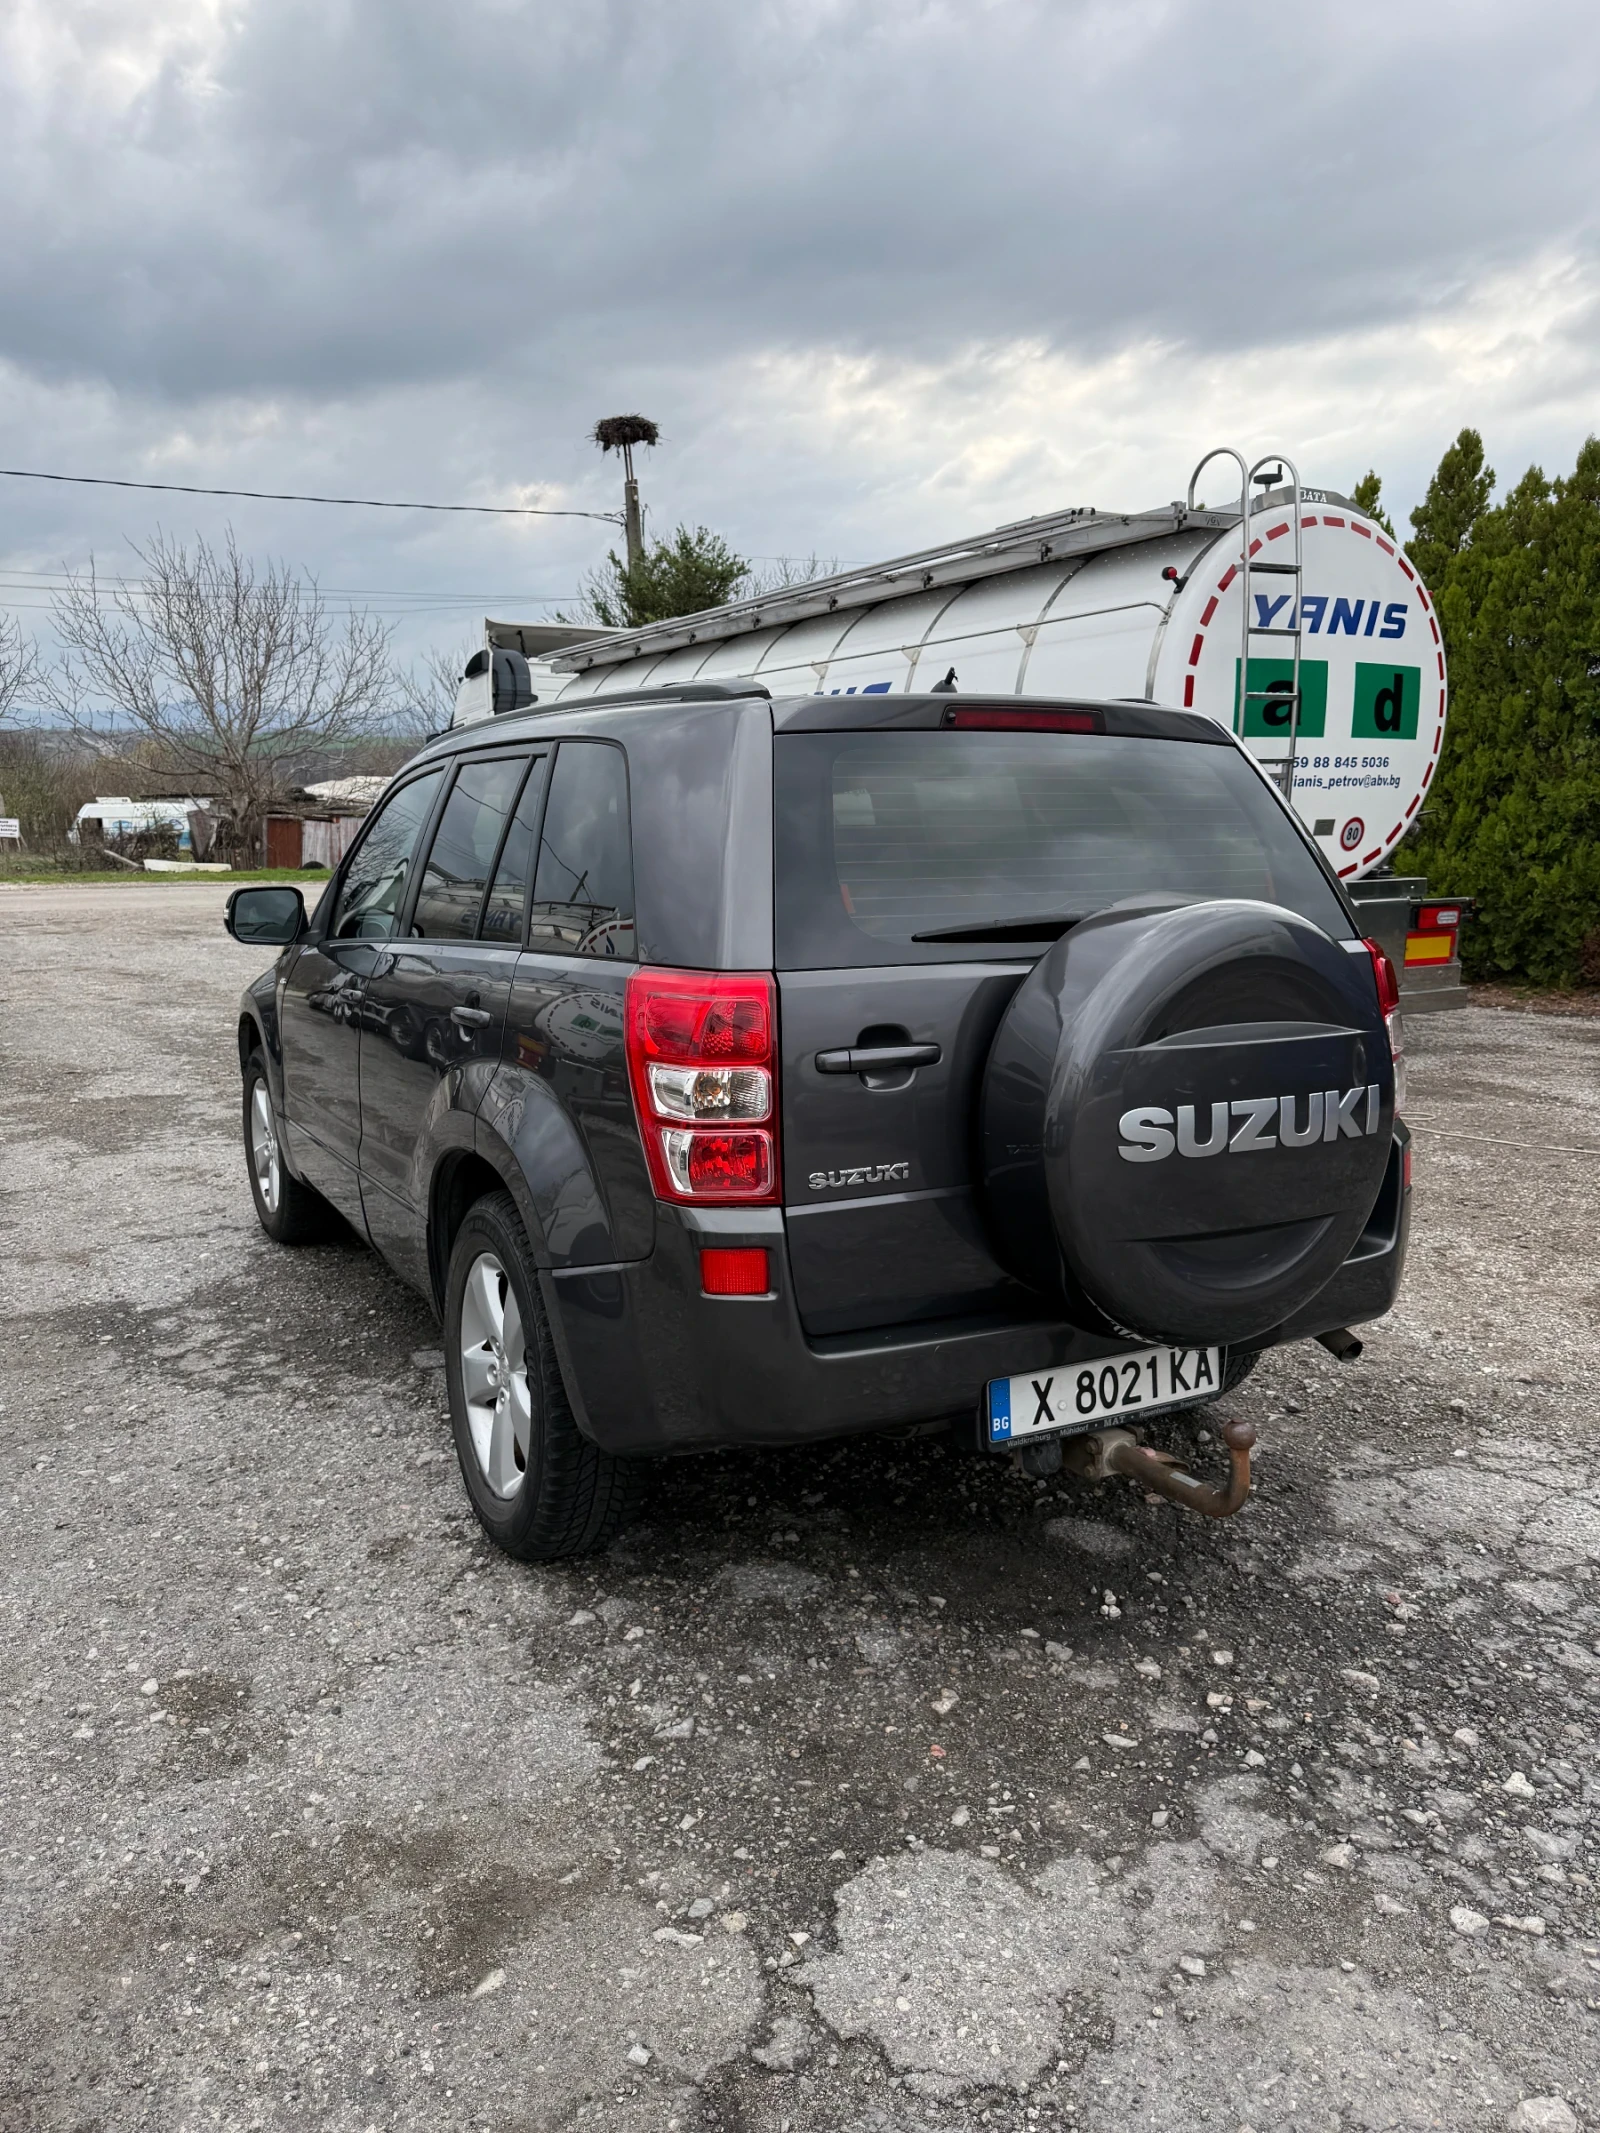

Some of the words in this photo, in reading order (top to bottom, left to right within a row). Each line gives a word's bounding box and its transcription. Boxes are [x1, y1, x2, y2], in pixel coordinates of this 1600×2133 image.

[1254, 594, 1409, 639] YANIS
[1262, 680, 1303, 727] a
[1373, 673, 1404, 732] d
[1313, 756, 1330, 768] 88
[1334, 756, 1358, 768] 845
[1361, 756, 1390, 768] 5036
[1346, 827, 1359, 841] 80
[1117, 1083, 1380, 1163] SUZUKI
[808, 1162, 909, 1190] SUZUKI
[993, 1416, 1010, 1432] BG
[1060, 1423, 1089, 1437] Mühldorf
[1103, 1415, 1126, 1428] MAT
